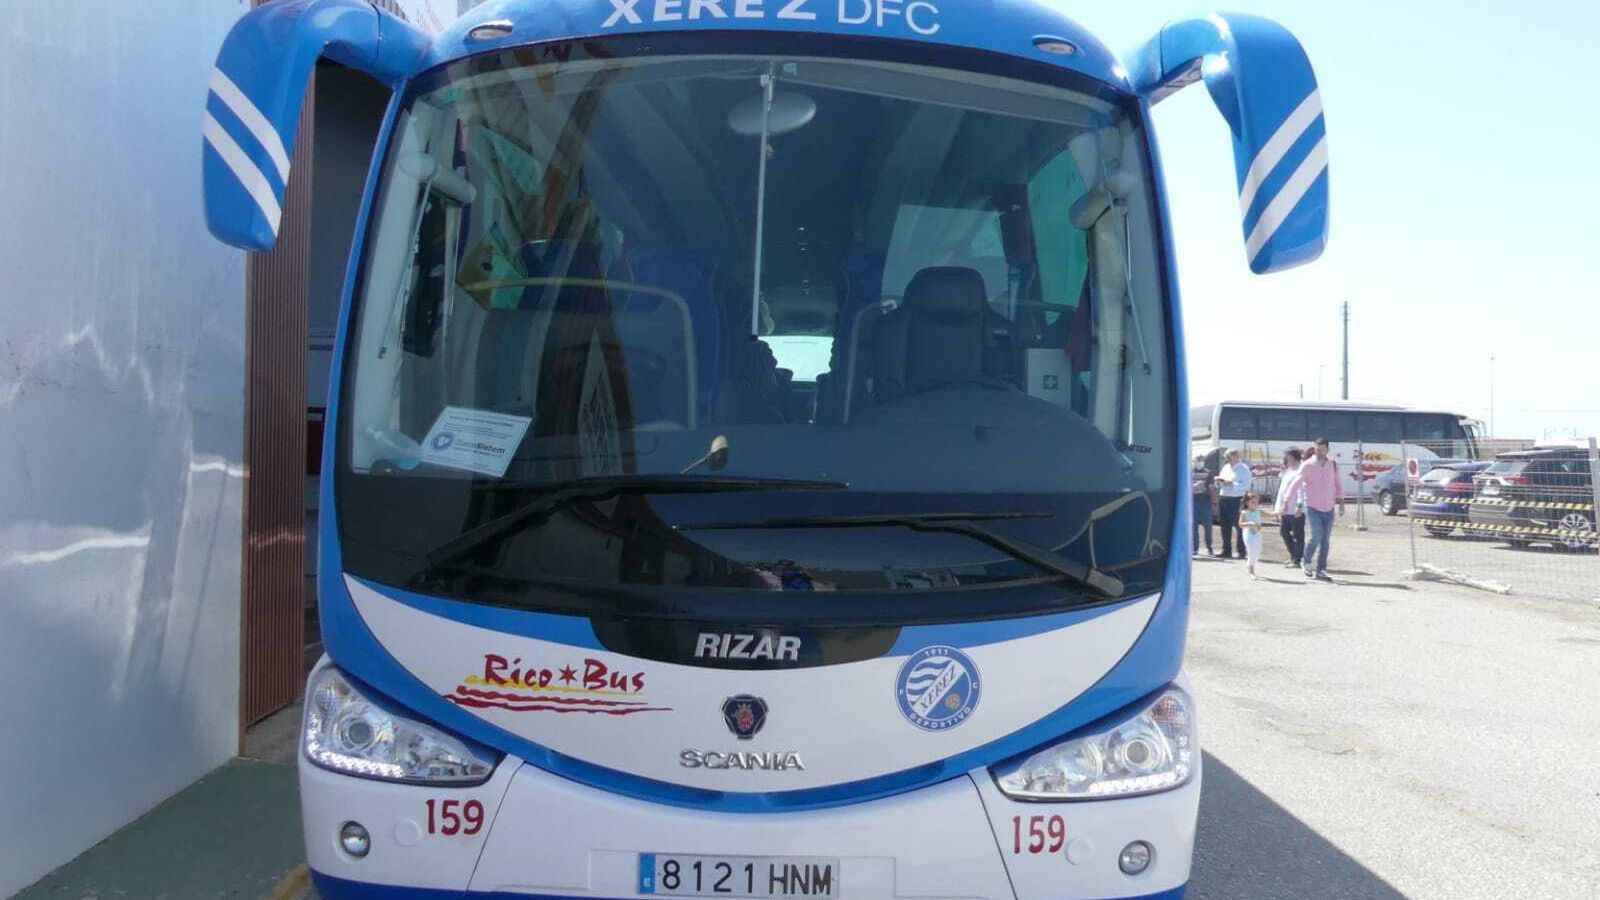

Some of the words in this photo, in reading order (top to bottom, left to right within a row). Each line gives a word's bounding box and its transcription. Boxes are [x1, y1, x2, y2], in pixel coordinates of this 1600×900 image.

[838, 0, 941, 35] DFC
[694, 632, 802, 661] RIZAR
[583, 659, 646, 694] Bus
[679, 749, 807, 771] SCANIA
[425, 799, 484, 836] 159
[1012, 814, 1065, 854] 159
[662, 859, 754, 894] 8121
[768, 863, 832, 895] HNM
